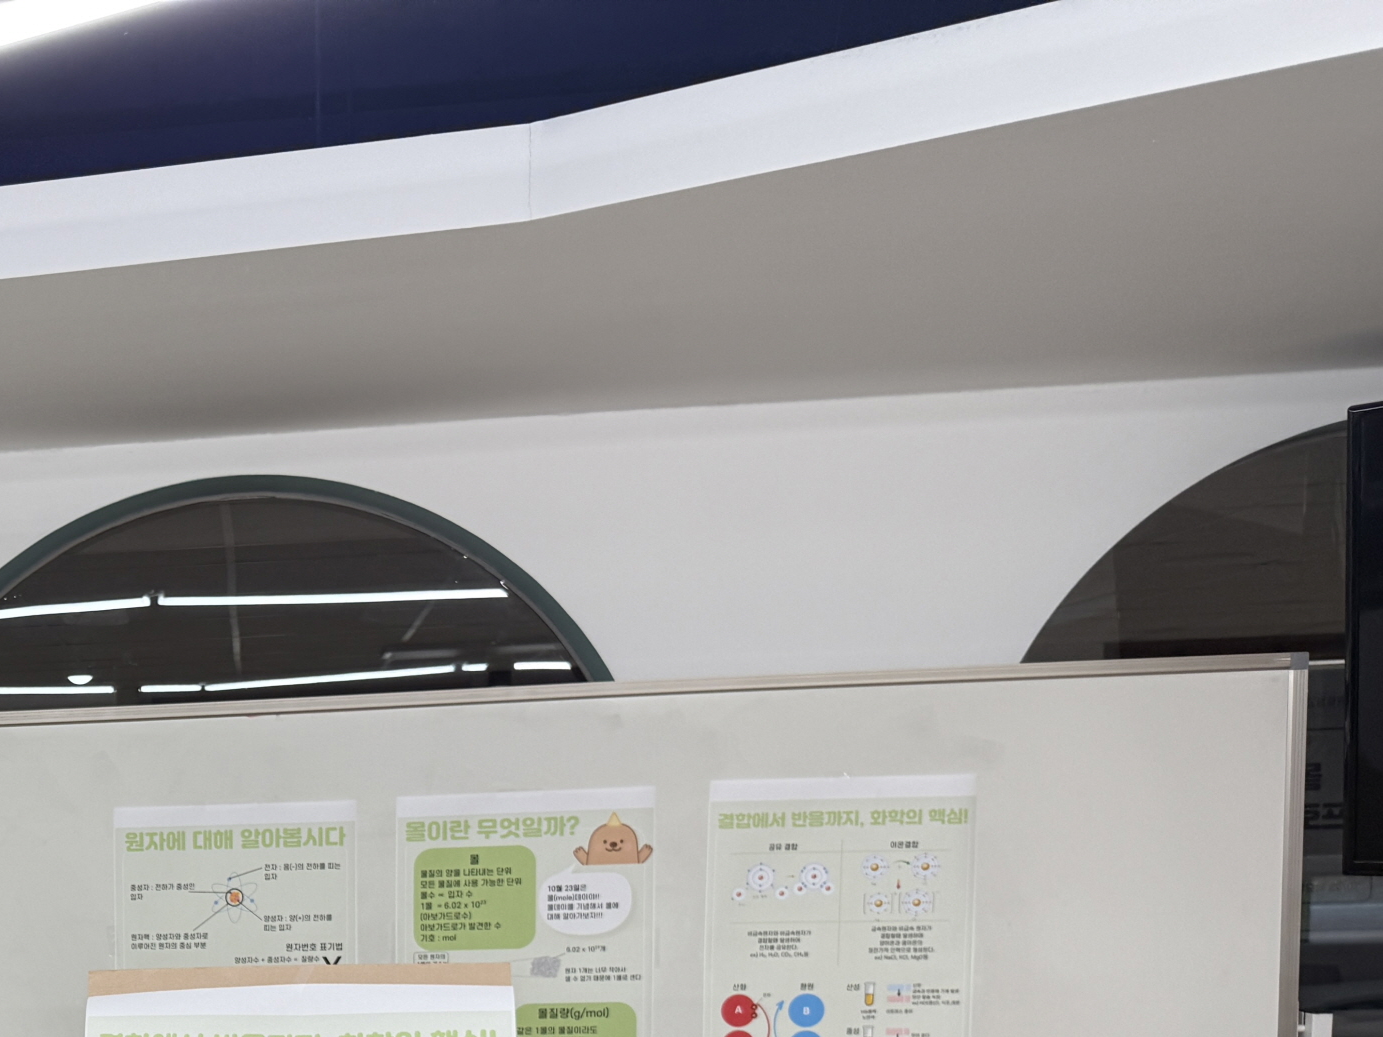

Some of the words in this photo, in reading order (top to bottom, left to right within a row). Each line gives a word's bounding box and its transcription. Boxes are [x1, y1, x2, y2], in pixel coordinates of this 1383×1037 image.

[125, 831, 186, 852] 원자에
[193, 830, 233, 850] 대해
[241, 826, 346, 849] 알아봅시다
[406, 820, 470, 842] 몰이란
[477, 816, 579, 839] 무엇일까?
